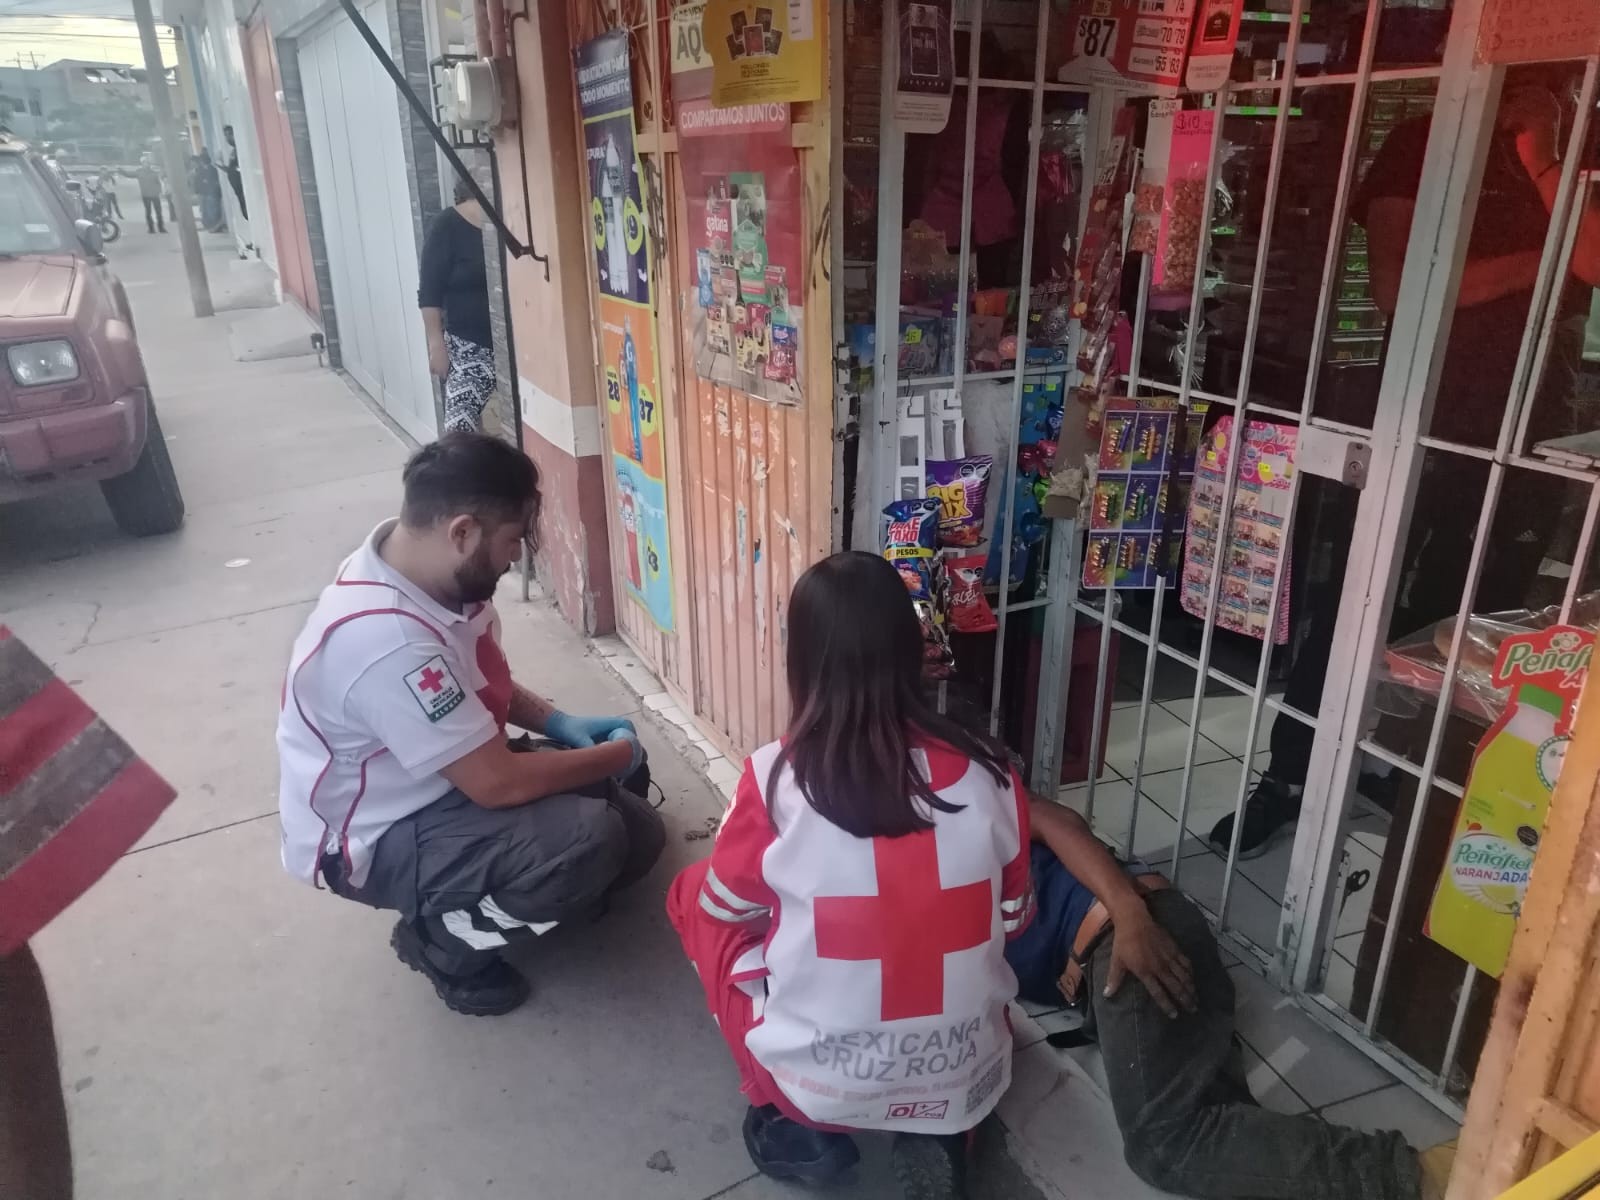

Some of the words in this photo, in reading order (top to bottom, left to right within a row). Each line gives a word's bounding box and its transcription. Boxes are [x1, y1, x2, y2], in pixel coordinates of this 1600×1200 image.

[1079, 17, 1116, 57] $87
[681, 107, 745, 129] COMPARTAMOS
[745, 103, 786, 123] JUNTOS
[608, 378, 620, 402] 28
[639, 398, 654, 424] 37
[927, 481, 964, 504] BIG
[896, 548, 919, 557] PESOS
[1455, 867, 1528, 883] NARANJADA
[811, 1016, 981, 1058] MEXICANA
[811, 1042, 897, 1083] CRUZ
[904, 1041, 977, 1078] ROJA
